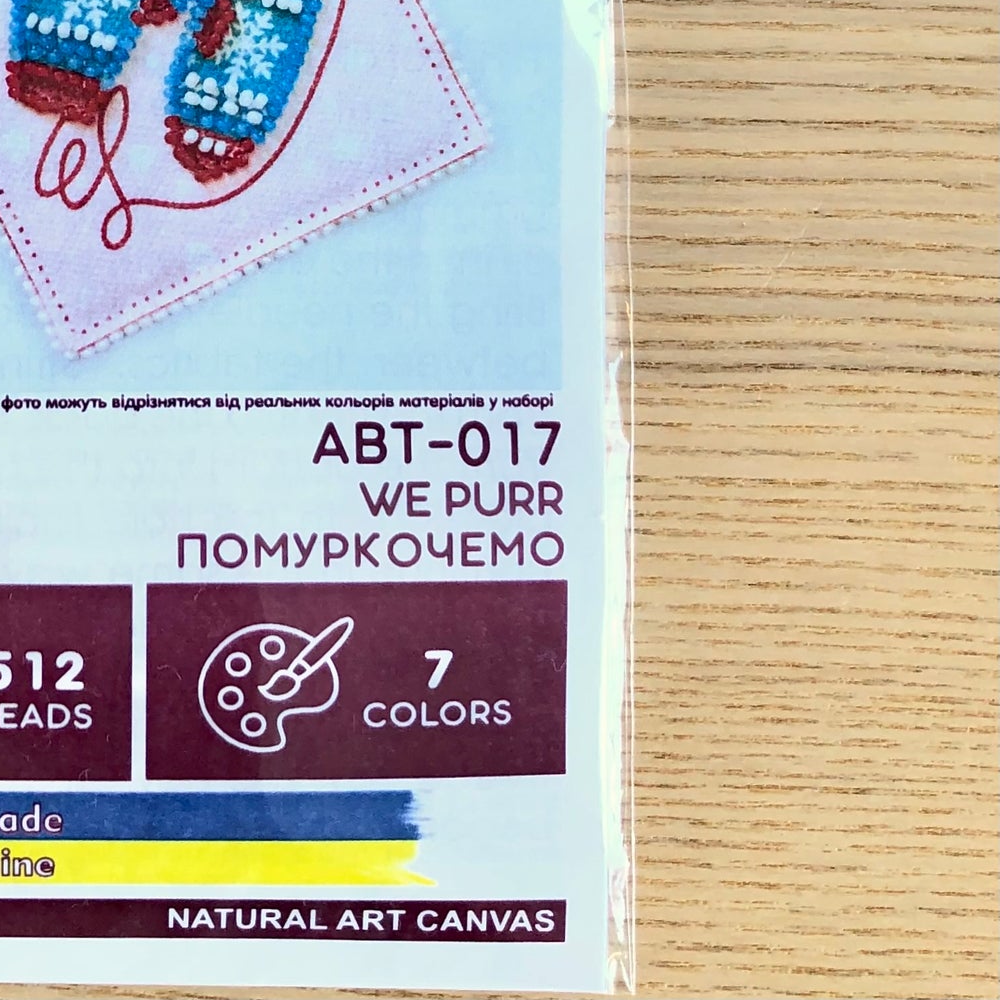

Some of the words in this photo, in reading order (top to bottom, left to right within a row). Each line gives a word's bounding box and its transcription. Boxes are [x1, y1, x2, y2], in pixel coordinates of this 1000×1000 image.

[0, 394, 42, 413] фото
[45, 398, 108, 413] можуть
[111, 393, 212, 412] відрізнятися
[215, 393, 241, 411] від
[244, 396, 322, 412] реальних
[325, 393, 395, 412] кольорів
[399, 393, 485, 412] матеріалів
[489, 397, 498, 412] у
[502, 392, 554, 411] наборі
[312, 420, 561, 467] ABT-017
[359, 481, 432, 518] WE
[445, 480, 564, 517] PURR
[177, 530, 565, 570] ПОМУРКОЧЕМО
[424, 649, 454, 689] 7
[363, 699, 512, 728] COLORS
[168, 907, 328, 930] NATURAL
[335, 909, 407, 931] ART
[416, 909, 555, 933] CANVAS
